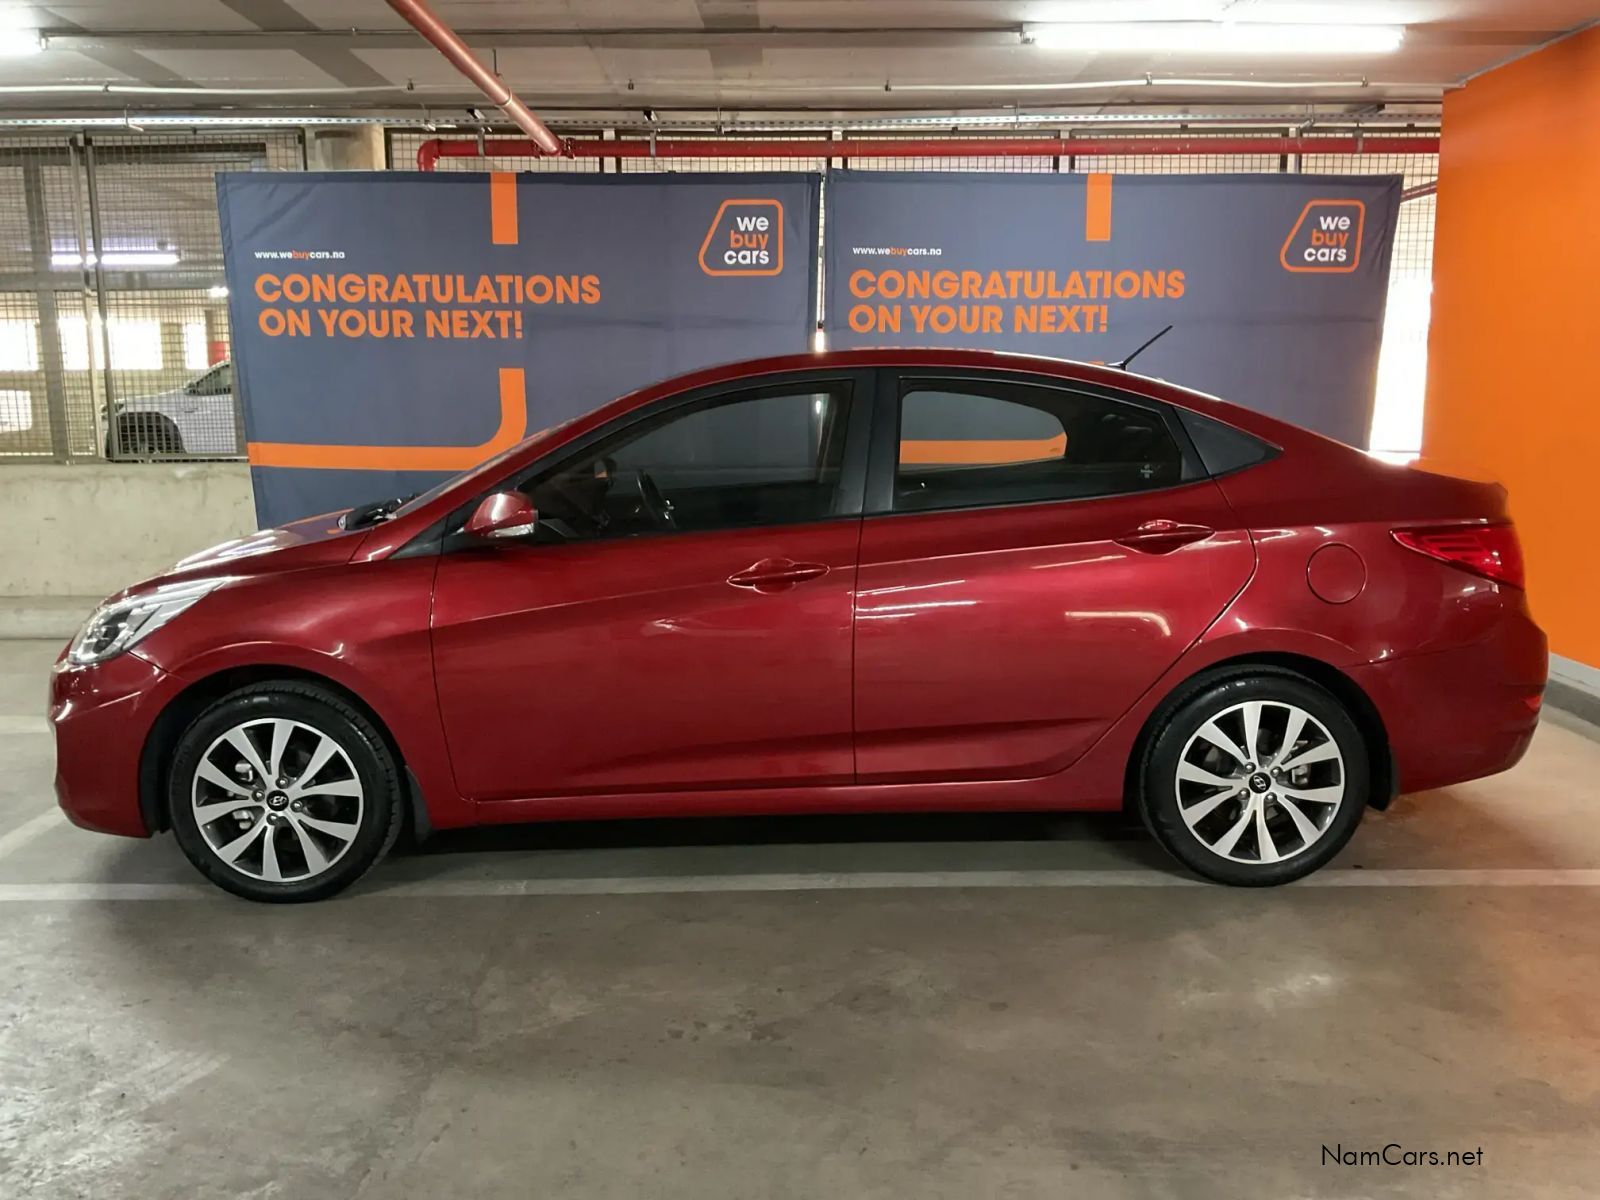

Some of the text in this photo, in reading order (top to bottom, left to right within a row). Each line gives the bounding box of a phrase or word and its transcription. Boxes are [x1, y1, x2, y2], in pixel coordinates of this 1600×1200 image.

[736, 216, 769, 231] we
[1320, 216, 1351, 231] we
[730, 229, 769, 250] buy
[1311, 228, 1349, 248] buy
[254, 250, 346, 261] www.webuycars.na
[724, 250, 770, 265] cars
[852, 246, 942, 257] www.webuycars.na
[1304, 247, 1347, 262] cars
[254, 272, 601, 304] CONGRATULATIONS
[849, 269, 1186, 299] CONGRATULATIONS
[258, 308, 523, 339] ON YOUR NEXT!
[848, 304, 1108, 334] ON YOUR NEXT!
